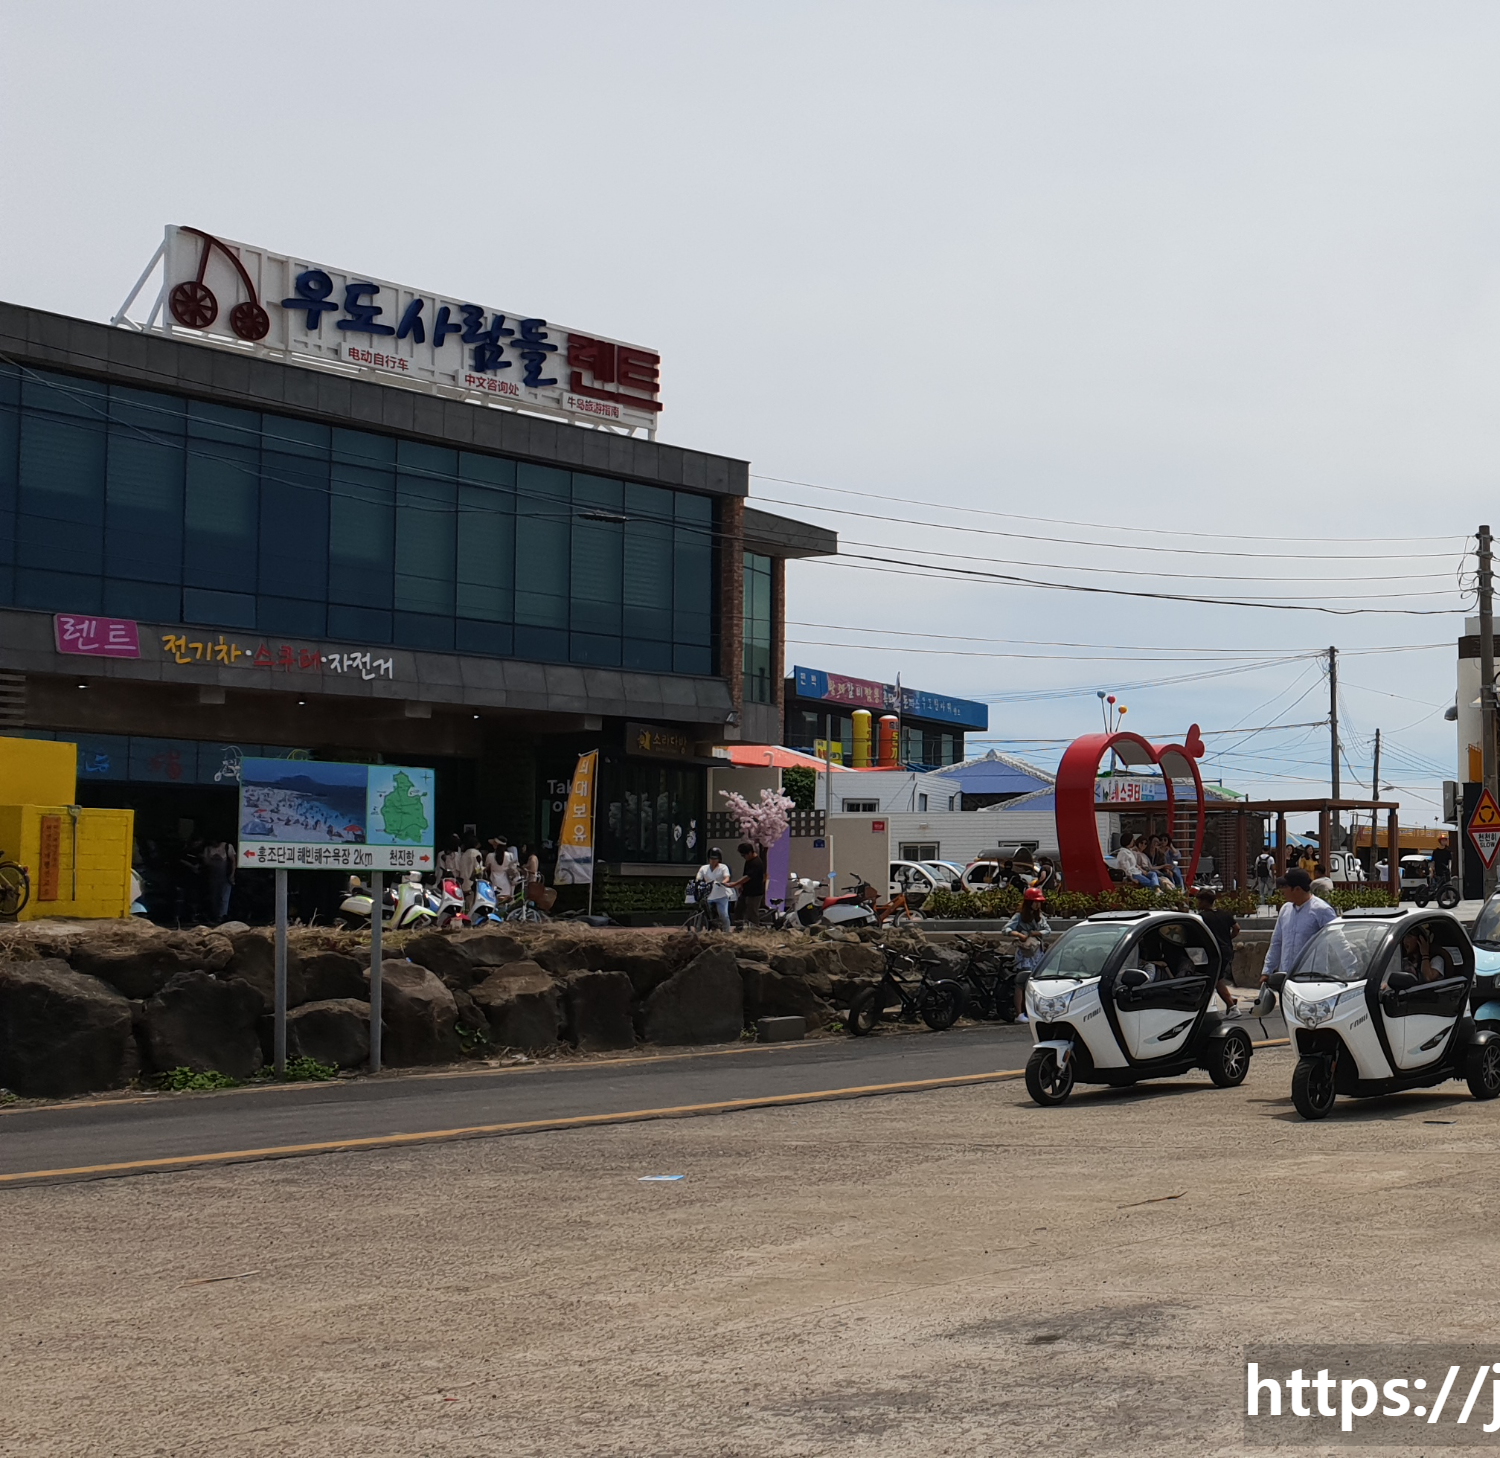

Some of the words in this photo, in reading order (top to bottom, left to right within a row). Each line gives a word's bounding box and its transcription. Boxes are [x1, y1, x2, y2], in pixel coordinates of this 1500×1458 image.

[281, 269, 558, 388] 우도사람들
[568, 332, 664, 412] 렌트
[348, 346, 409, 372] 电动自行车
[465, 374, 520, 397] 中文咨询处
[60, 617, 137, 650] 렌트
[547, 779, 572, 795] Tak
[1478, 833, 1497, 841] 천천히
[353, 848, 373, 867] 2km
[389, 850, 415, 866] 천진항
